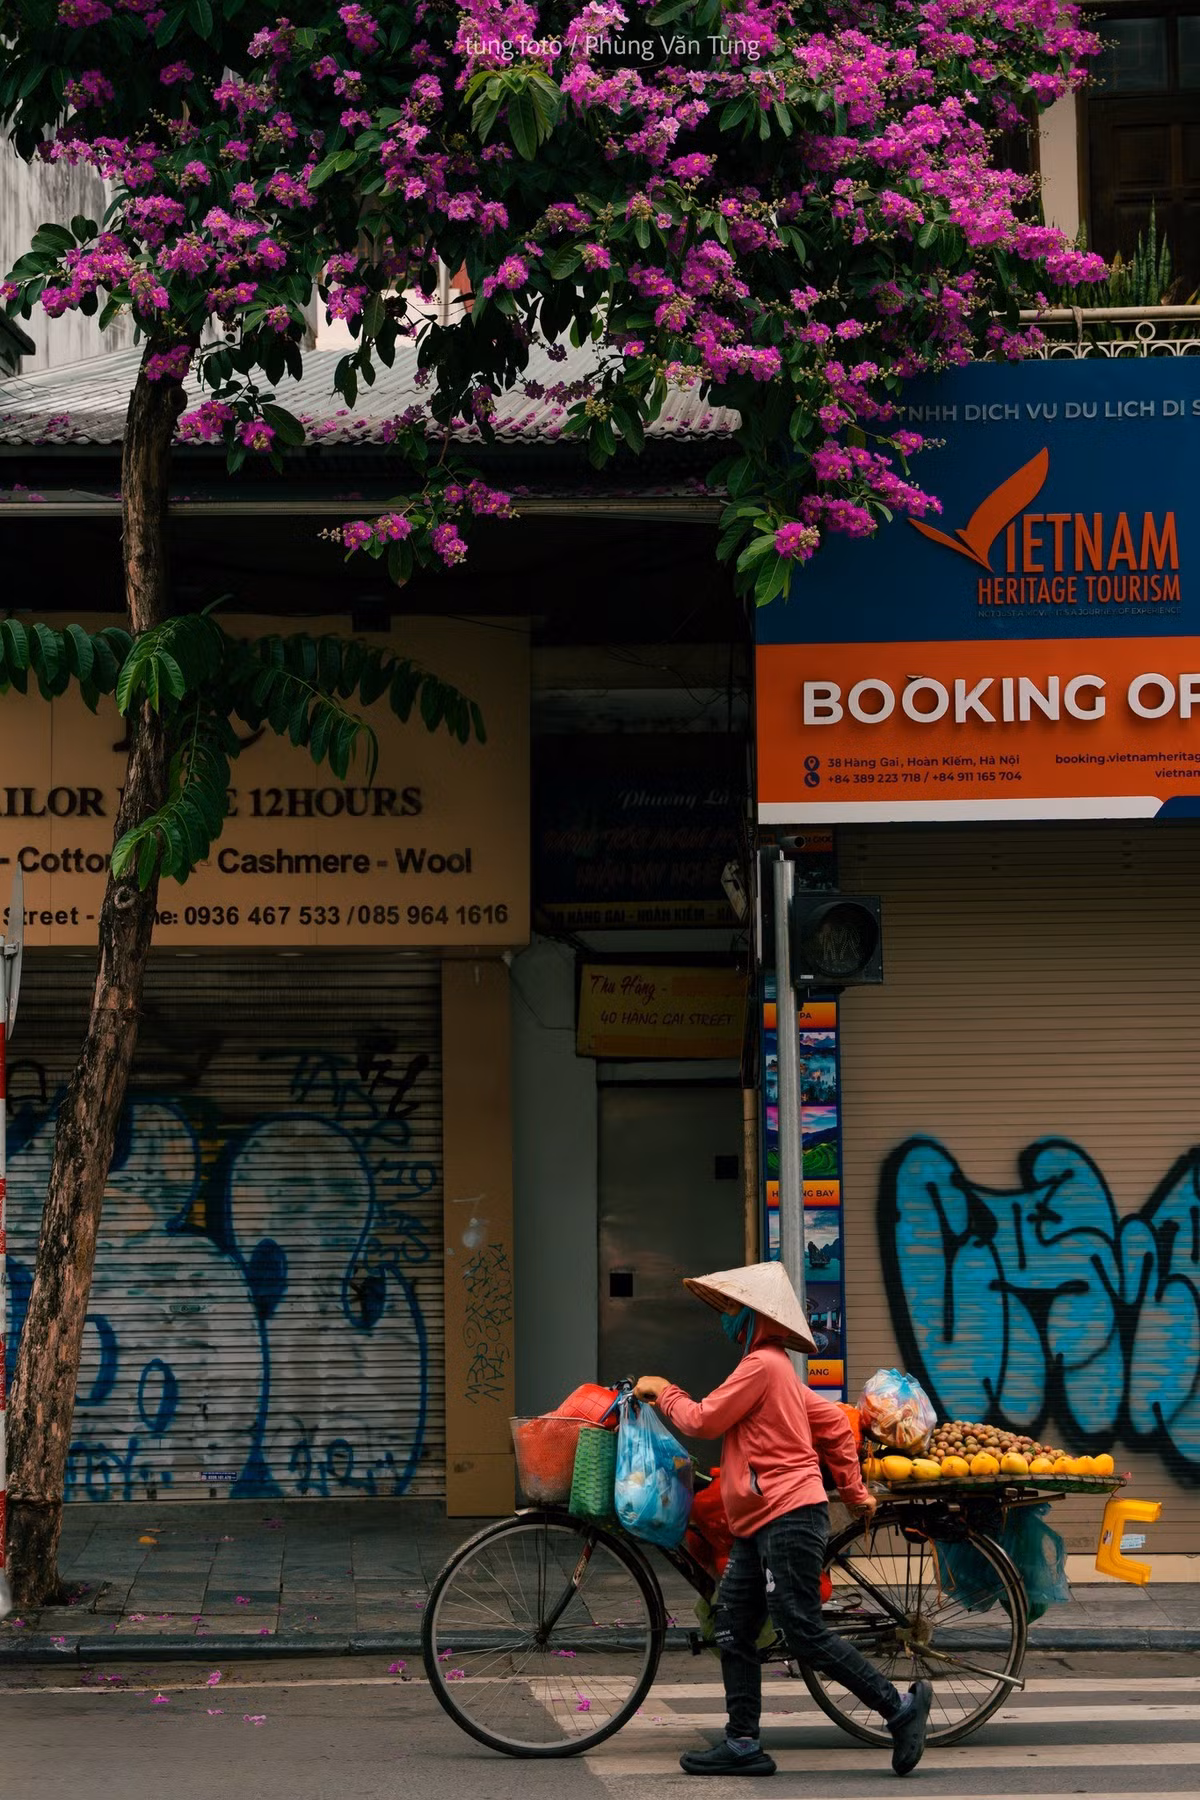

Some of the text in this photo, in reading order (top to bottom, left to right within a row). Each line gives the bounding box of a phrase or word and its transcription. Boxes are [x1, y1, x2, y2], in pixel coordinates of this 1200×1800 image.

[965, 404, 1019, 424] DỊCH
[1026, 403, 1057, 423] VỤ
[1065, 402, 1097, 418] DU
[1105, 401, 1155, 421] LỊCH
[1162, 400, 1184, 417] DI
[977, 574, 1181, 606] HERITAGE TOURISM
[802, 674, 1106, 726] BOOKING
[827, 758, 841, 768] 38
[844, 756, 876, 770] Hàng
[907, 756, 938, 767] Hoàn
[980, 755, 995, 766] Hà
[999, 754, 1020, 766] Nội
[828, 774, 849, 784] +84
[853, 774, 874, 783] 389
[878, 773, 898, 783] 223
[902, 773, 921, 783] 718
[933, 772, 954, 782] +84
[958, 772, 974, 782] 911
[977, 772, 996, 782] 165
[999, 771, 1022, 781] 704
[0, 786, 106, 816] ILOR
[250, 786, 423, 817] 12HOURS
[218, 848, 370, 874] Cashmere
[395, 847, 472, 874] Wool
[184, 906, 239, 926] 0936
[247, 906, 290, 926] 467
[298, 905, 340, 926] 533
[407, 905, 448, 926] 964
[457, 904, 508, 926] 1616
[591, 975, 616, 994] Thu
[601, 1011, 617, 1024] 40
[663, 1012, 683, 1025] GAI
[689, 1013, 733, 1026] STREET
[816, 1189, 834, 1197] BAY
